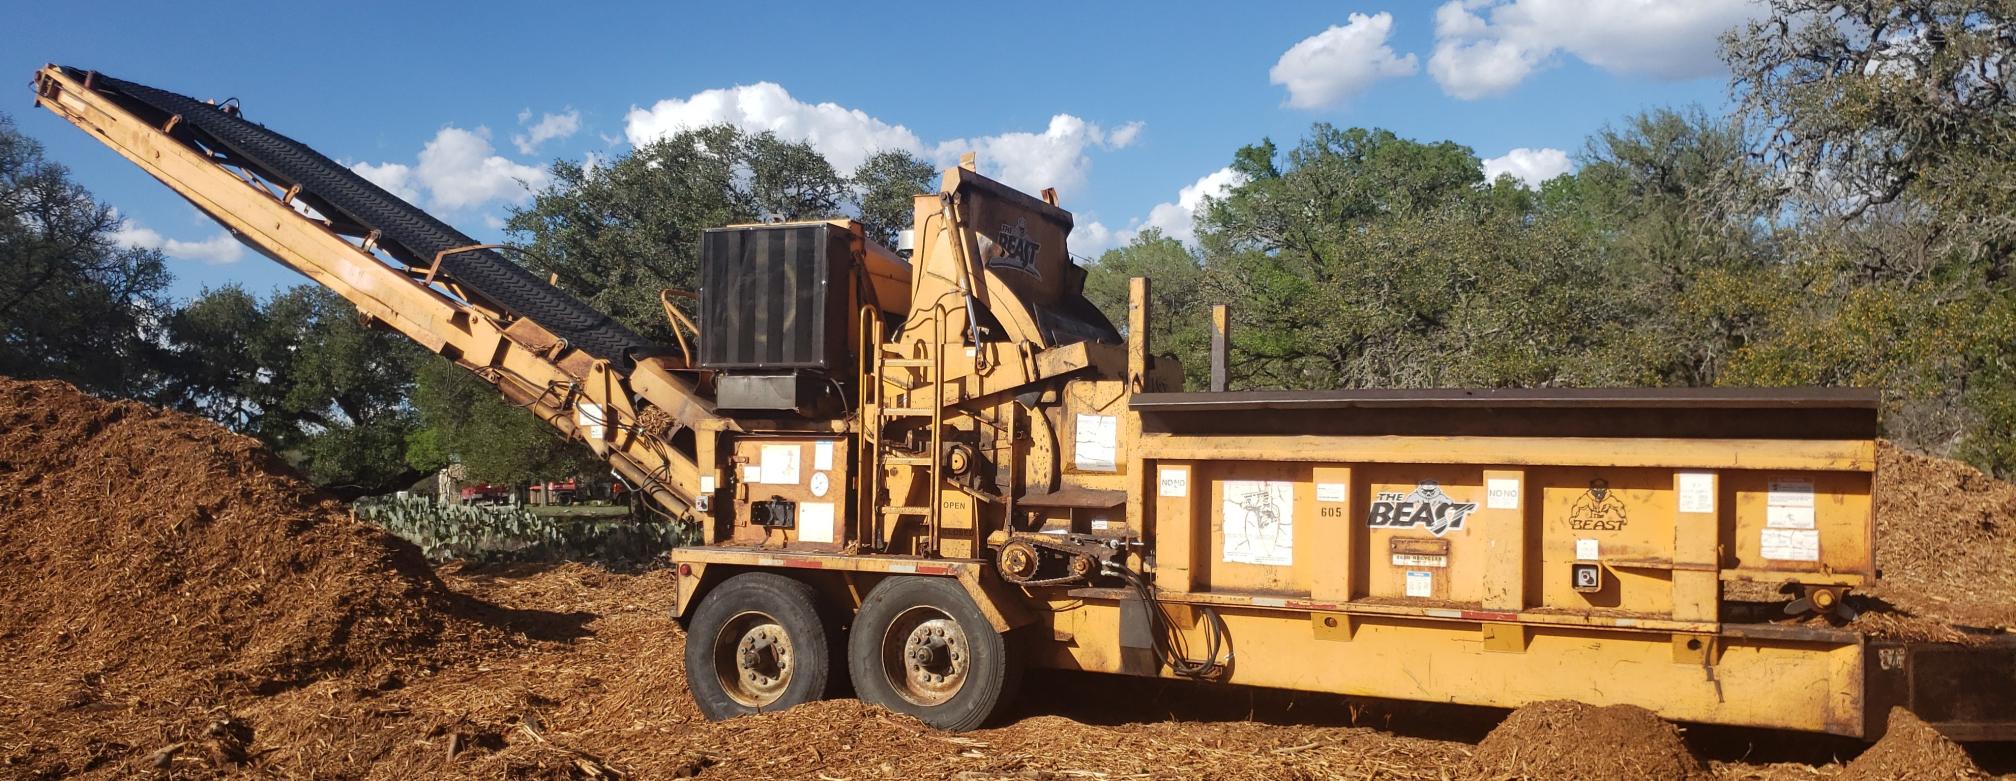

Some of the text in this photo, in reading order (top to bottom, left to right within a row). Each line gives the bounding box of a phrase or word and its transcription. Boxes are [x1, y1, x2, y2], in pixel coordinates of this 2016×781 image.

[1377, 493, 1404, 501] THE
[943, 501, 966, 510] OPEN
[1321, 507, 1342, 517] 605
[1366, 502, 1476, 535] BEAST
[1571, 519, 1624, 531] BEAST
